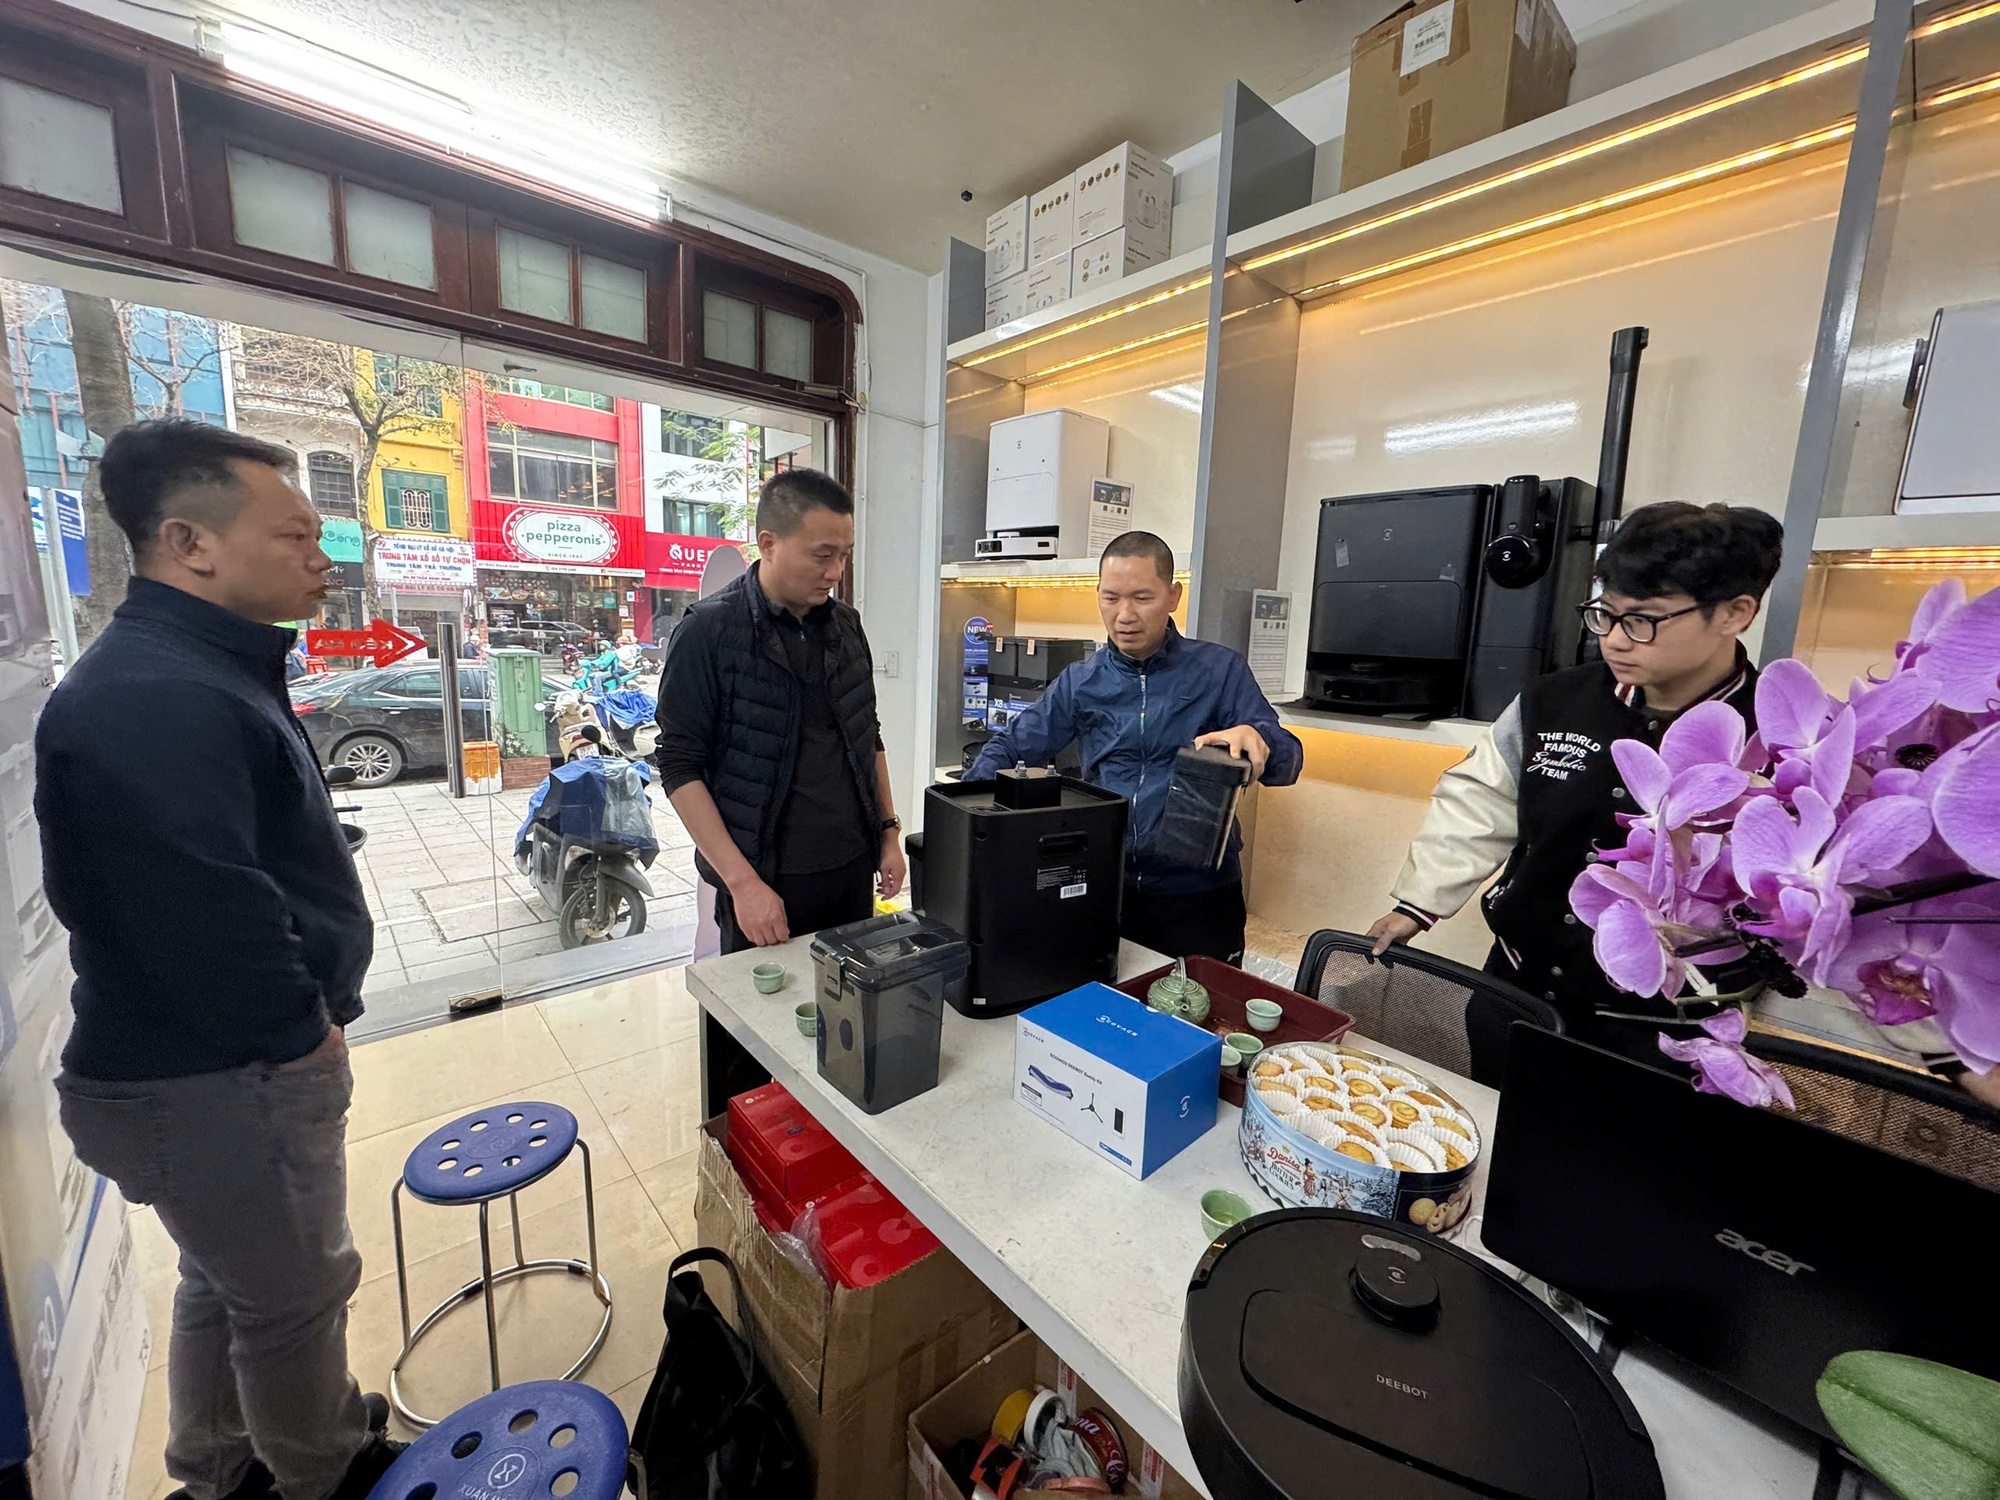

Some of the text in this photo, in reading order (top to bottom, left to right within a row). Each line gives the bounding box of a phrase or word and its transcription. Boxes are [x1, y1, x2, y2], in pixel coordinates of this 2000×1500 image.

[547, 519, 581, 532] pizza
[526, 532, 601, 545] pepperonis
[967, 625, 987, 633] NEW
[1537, 732, 1601, 752] THE WORLD
[1544, 743, 1587, 758] FAMOUS
[1541, 766, 1569, 781] TEAM
[1267, 1147, 1301, 1170] Danisa
[1714, 1228, 1816, 1275] acer
[1376, 1374, 1428, 1399] DEEBOT
